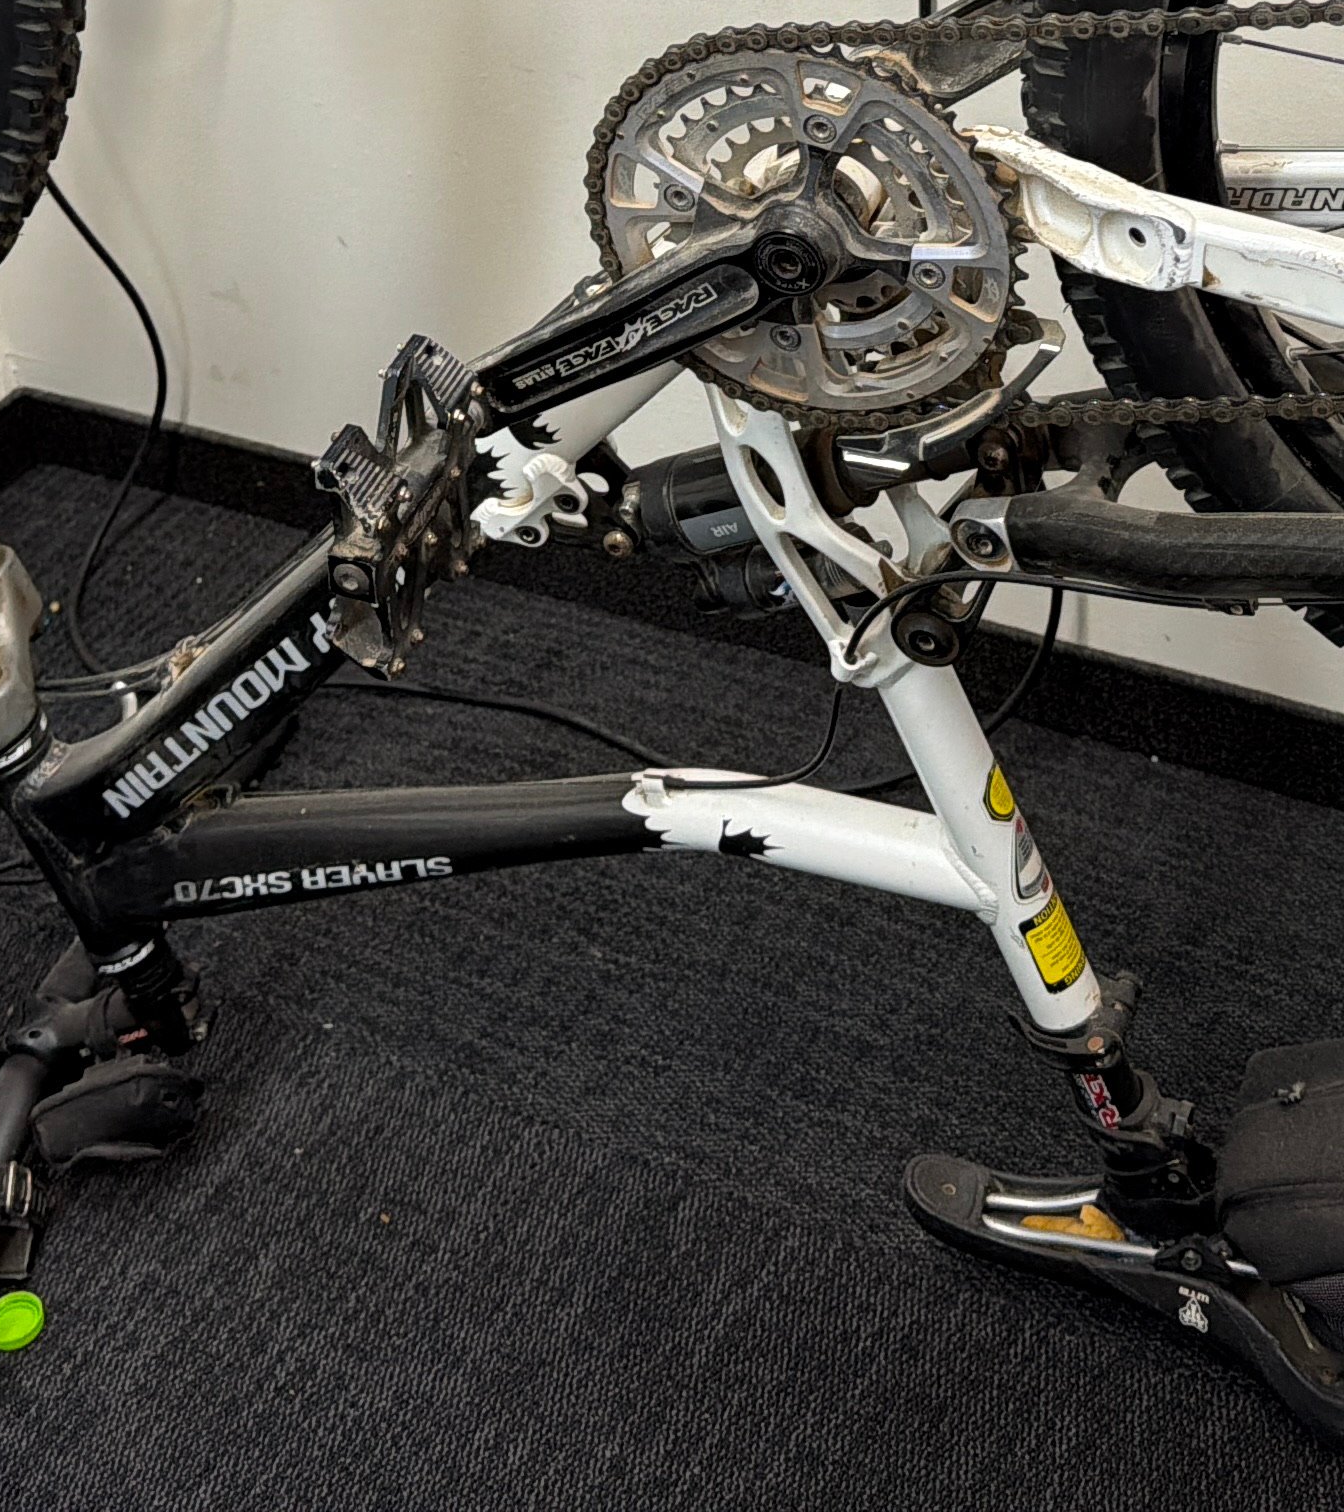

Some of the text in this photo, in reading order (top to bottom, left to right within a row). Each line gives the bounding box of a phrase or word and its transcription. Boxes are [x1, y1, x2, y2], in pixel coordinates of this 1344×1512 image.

[556, 283, 718, 378] RACE FACE
[515, 364, 557, 390] ATLAS
[710, 521, 740, 537] AIR
[102, 638, 312, 819] MOUNTAIN
[173, 856, 454, 903] SLAYER SXC70
